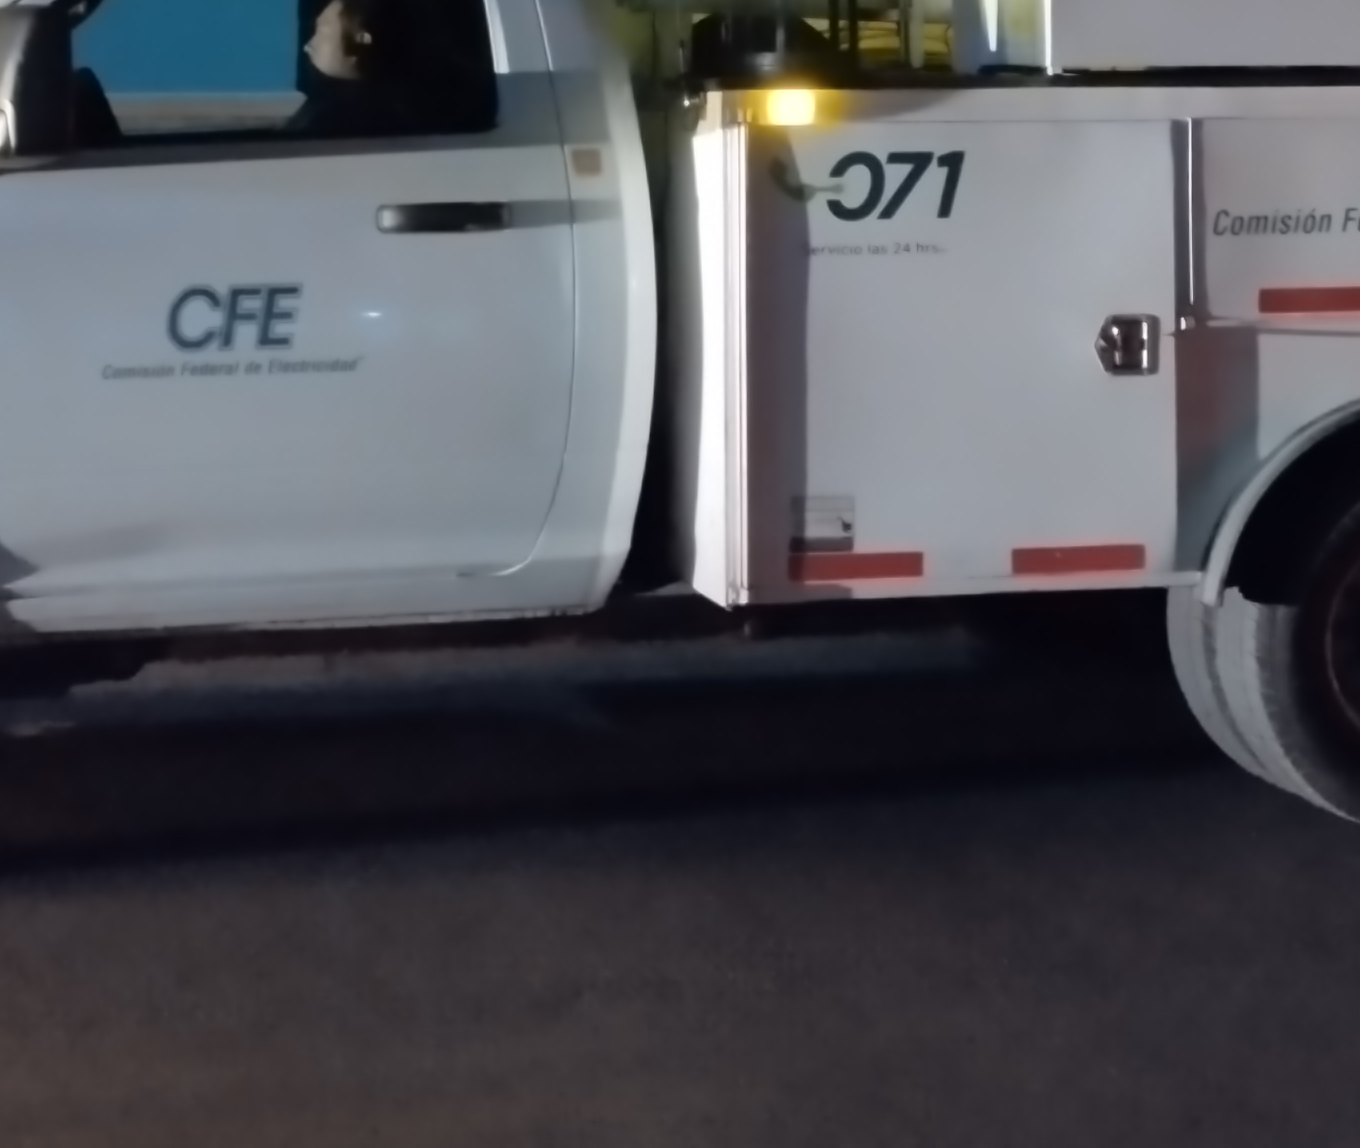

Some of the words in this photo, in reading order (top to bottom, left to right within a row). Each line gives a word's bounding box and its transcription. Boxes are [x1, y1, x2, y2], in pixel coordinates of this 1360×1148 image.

[826, 150, 966, 222] 071
[1213, 208, 1332, 237] Comisión
[167, 286, 301, 350] CFE
[244, 360, 263, 376] de
